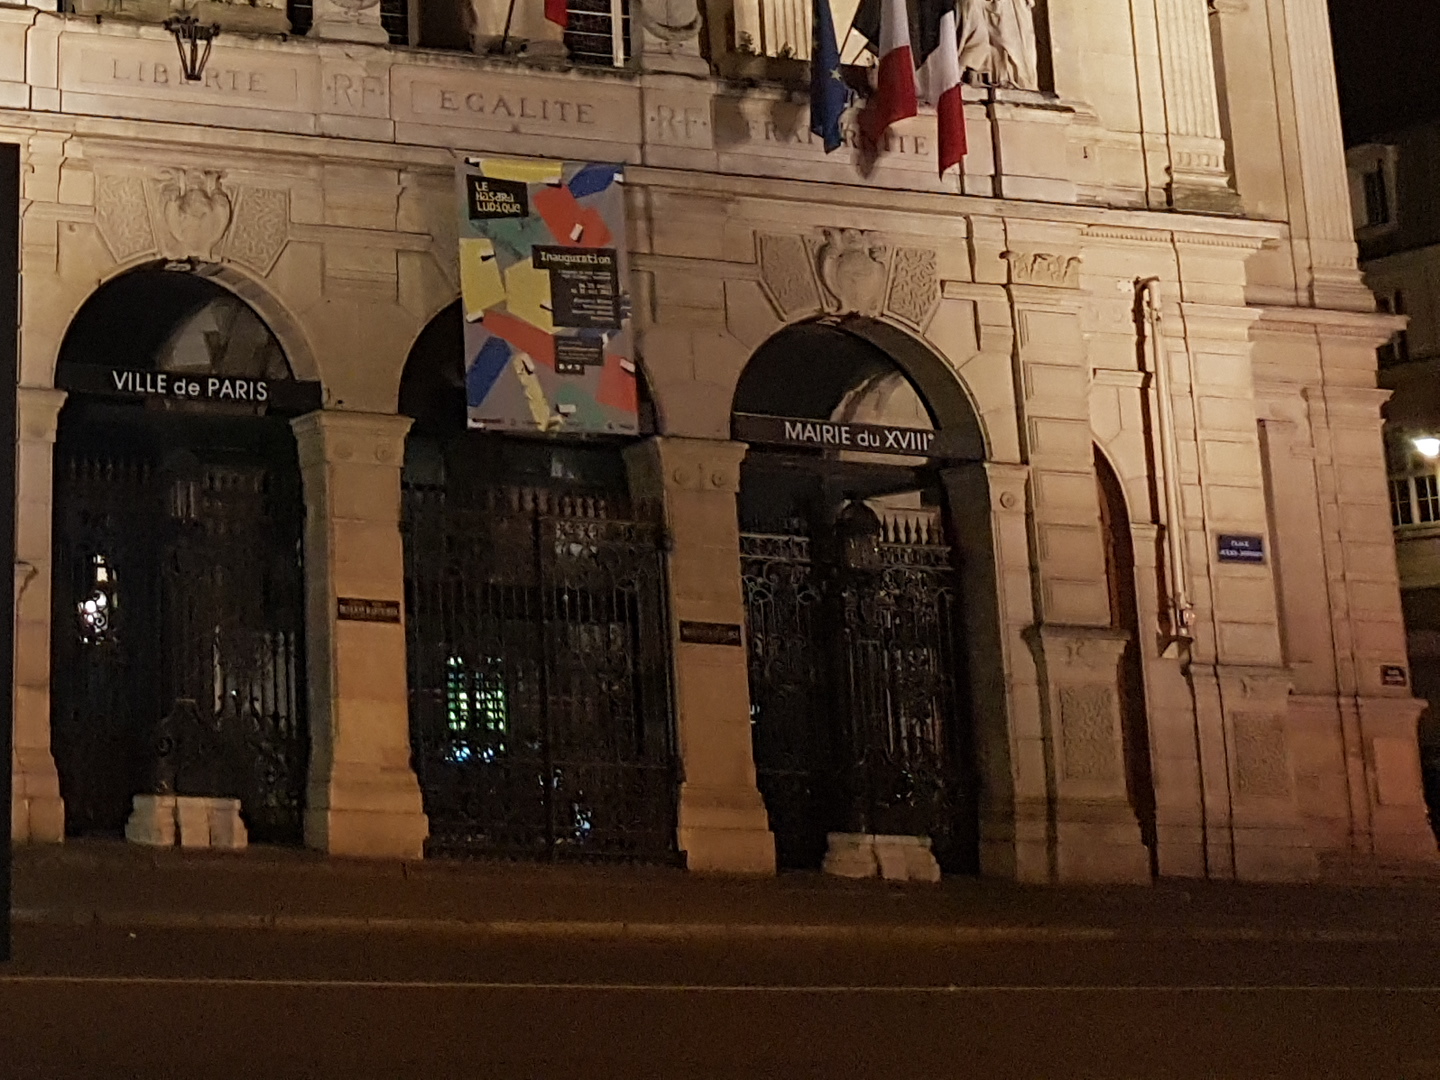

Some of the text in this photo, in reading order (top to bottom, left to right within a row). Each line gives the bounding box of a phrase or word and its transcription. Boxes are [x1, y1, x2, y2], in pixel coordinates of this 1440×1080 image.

[439, 89, 596, 124] EGALITE
[474, 181, 489, 191] LE
[540, 251, 612, 266] Inauguration
[112, 370, 268, 401] VILLE de PARIS
[784, 421, 852, 445] MAIRIE
[856, 430, 880, 447] du
